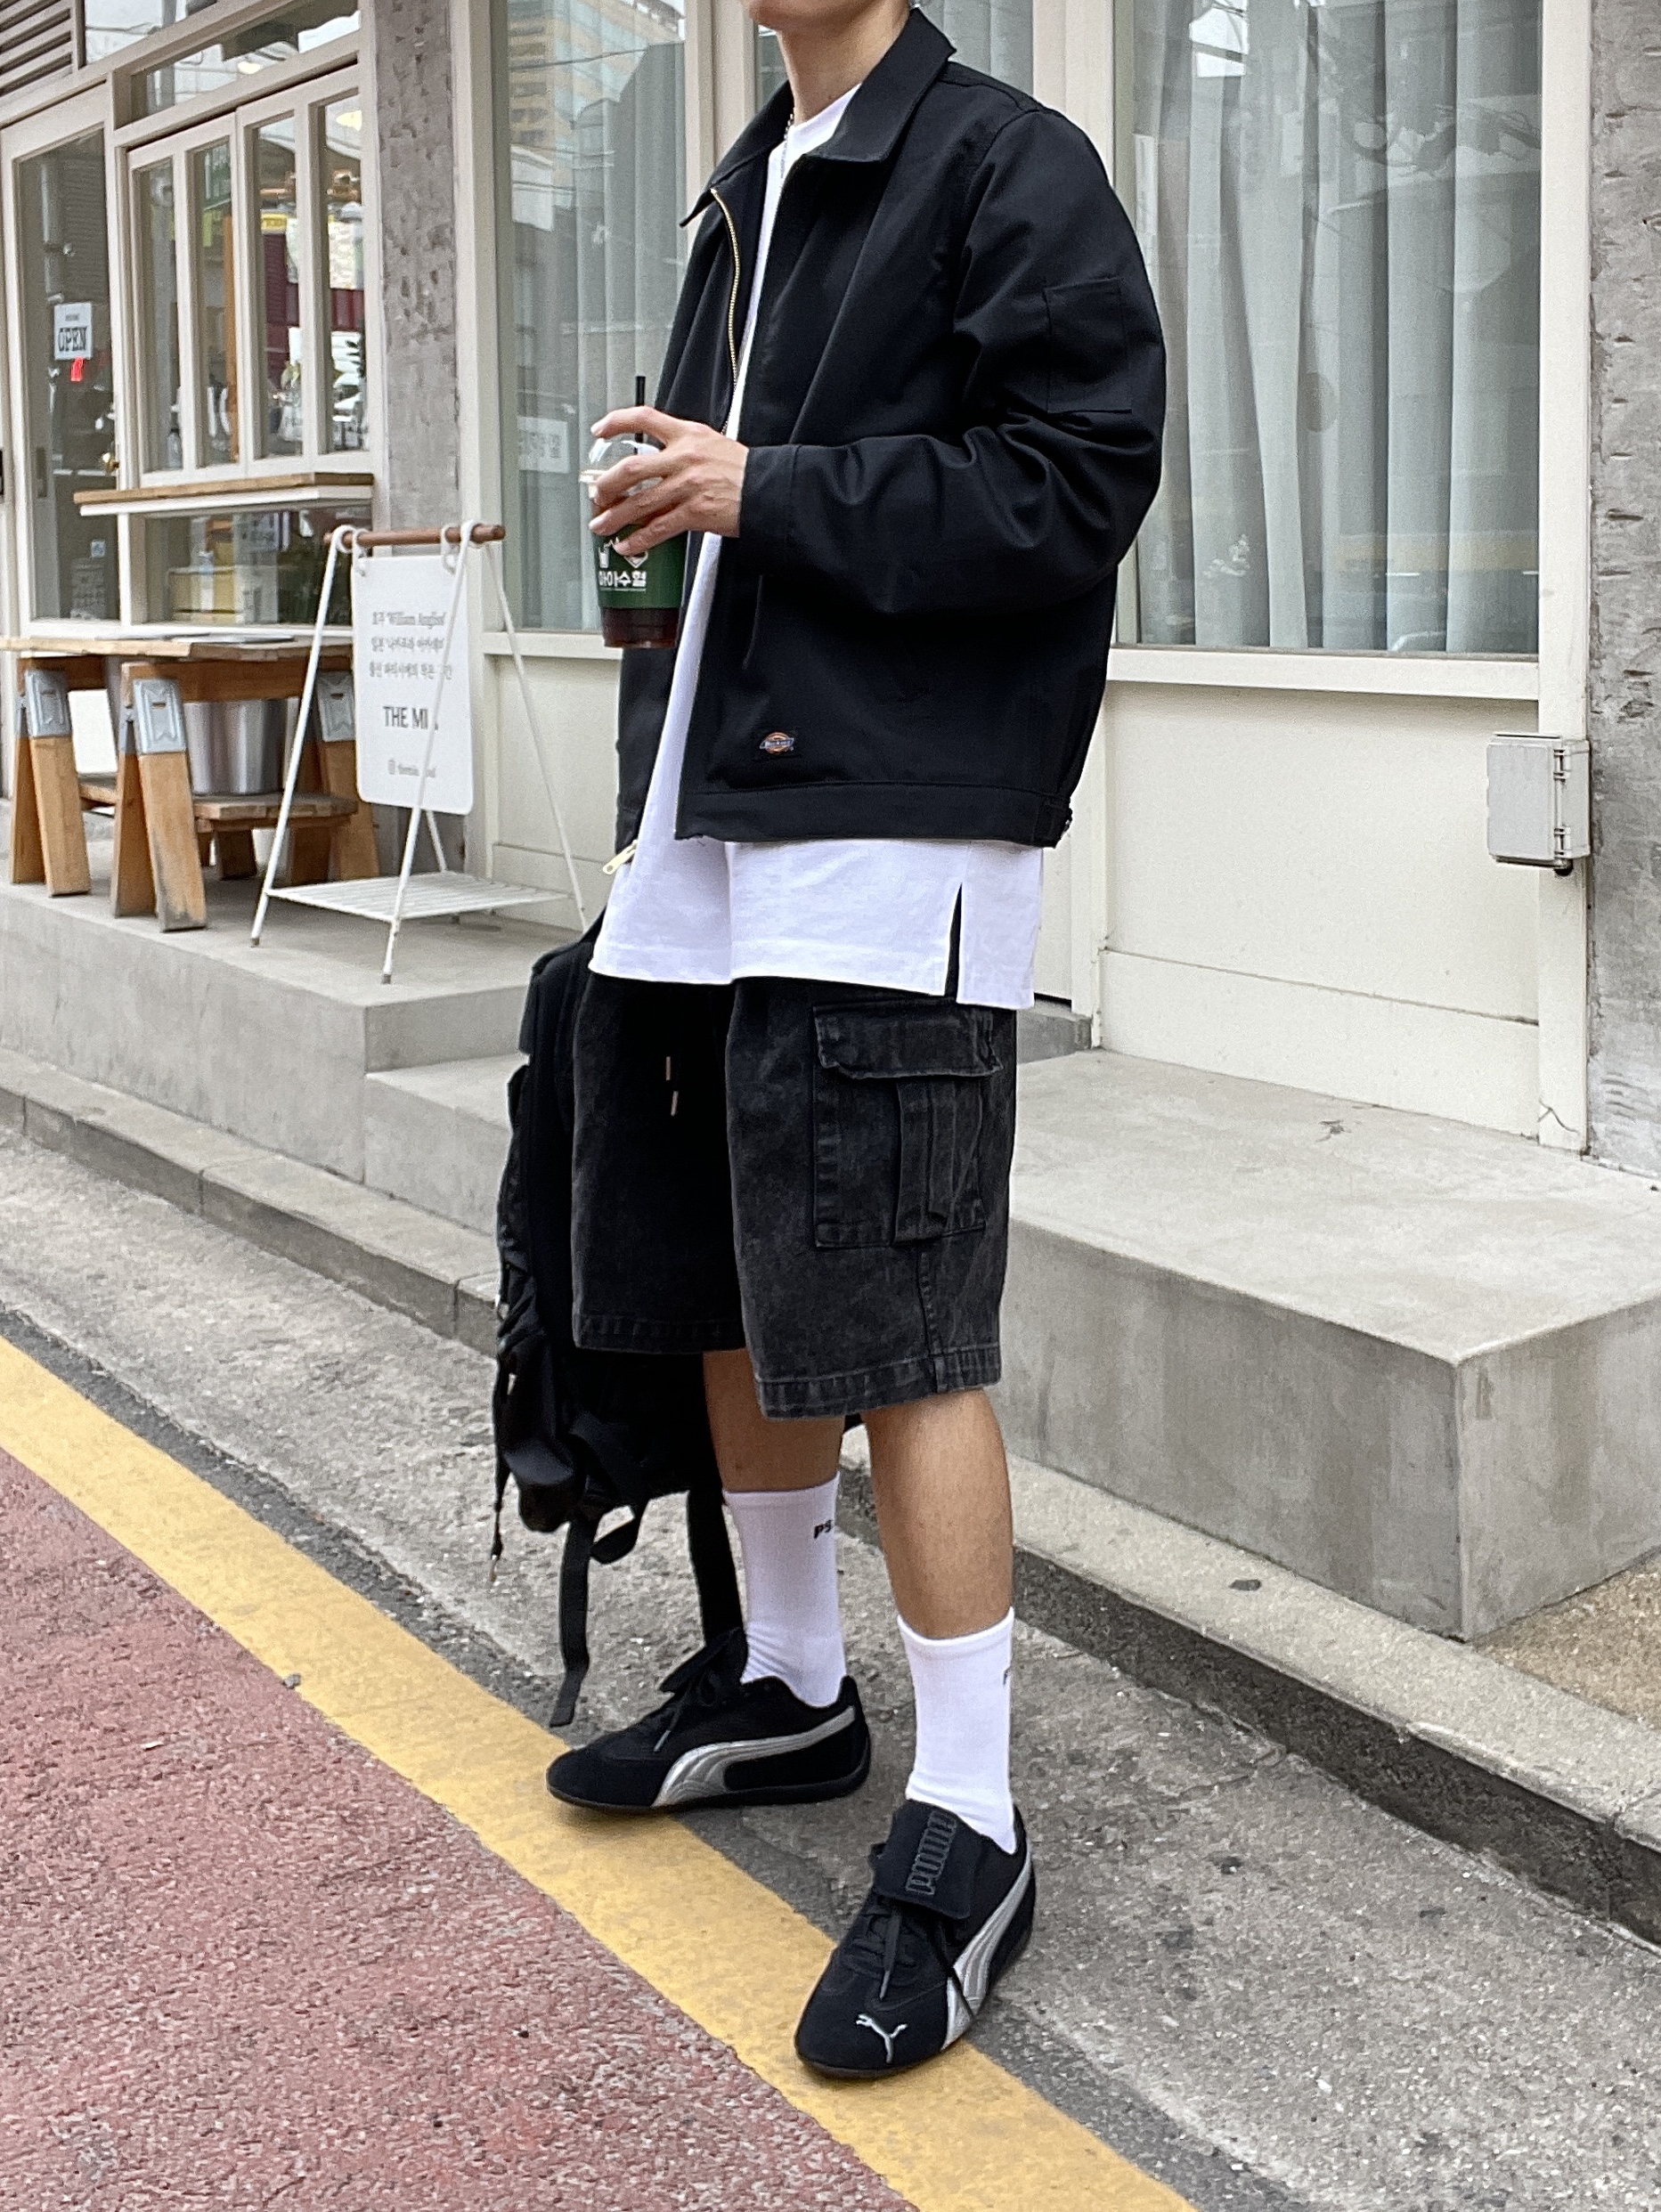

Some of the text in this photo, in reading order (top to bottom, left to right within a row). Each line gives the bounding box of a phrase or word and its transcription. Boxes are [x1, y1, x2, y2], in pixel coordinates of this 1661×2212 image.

[58, 326, 87, 352] OPEN
[383, 705, 439, 731] THE MI
